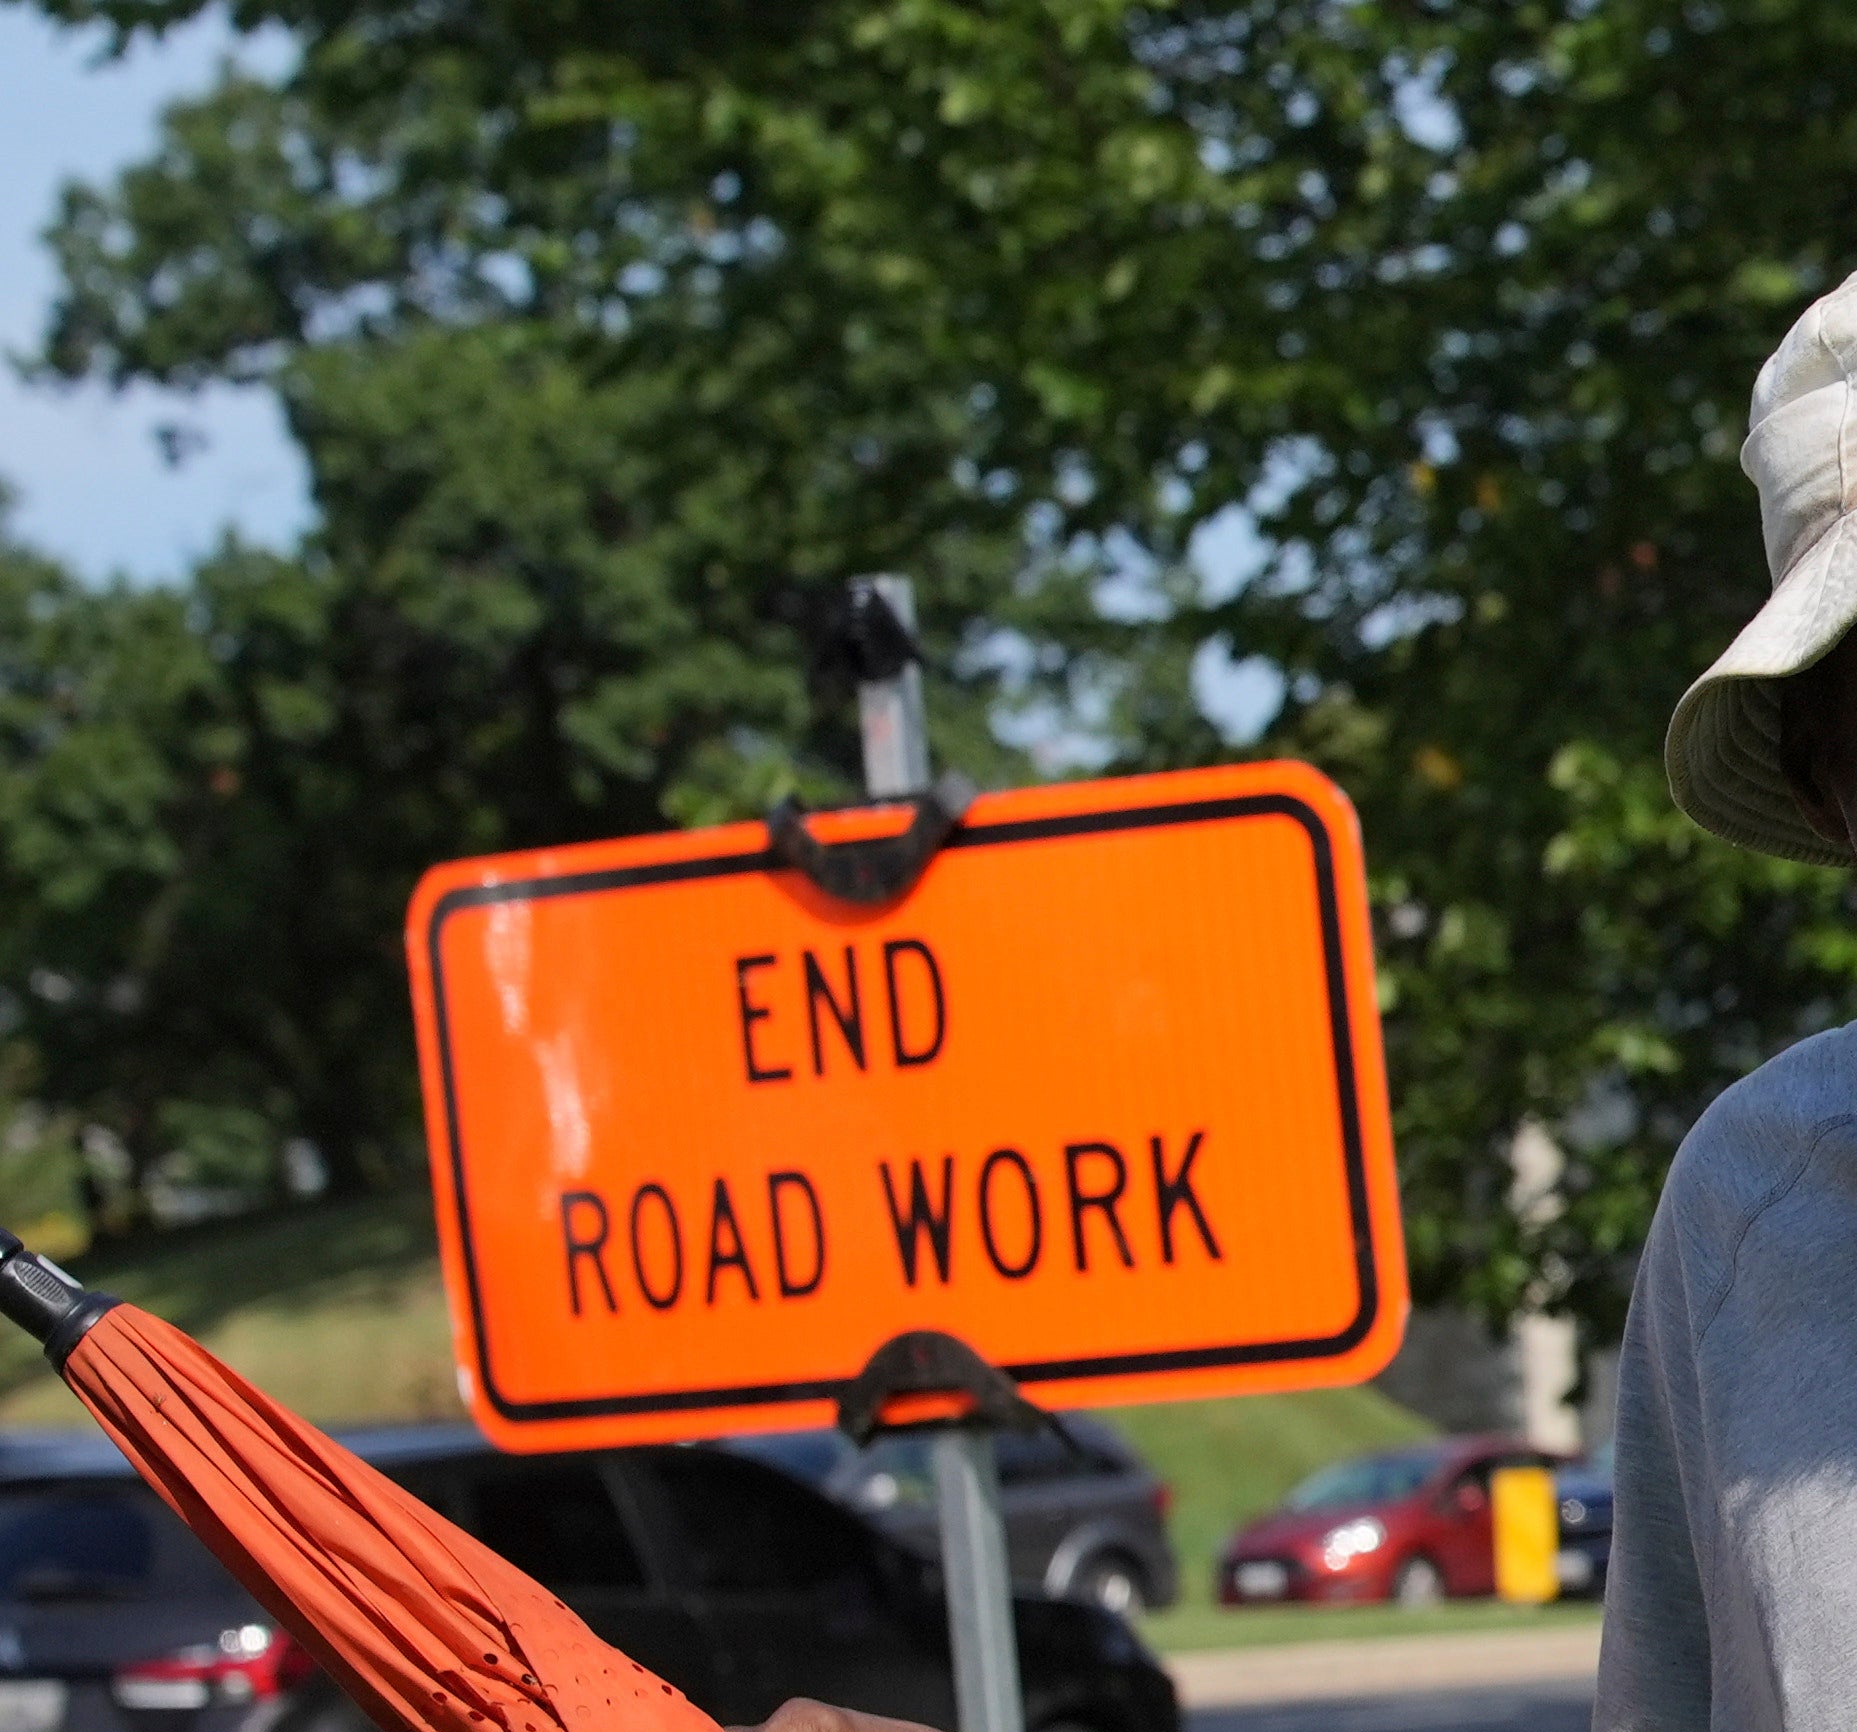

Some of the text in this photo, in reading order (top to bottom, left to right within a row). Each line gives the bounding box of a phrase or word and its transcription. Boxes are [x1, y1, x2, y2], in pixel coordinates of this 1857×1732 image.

[734, 938, 947, 1084] END
[560, 1131, 1223, 1316] ROAD WORK
